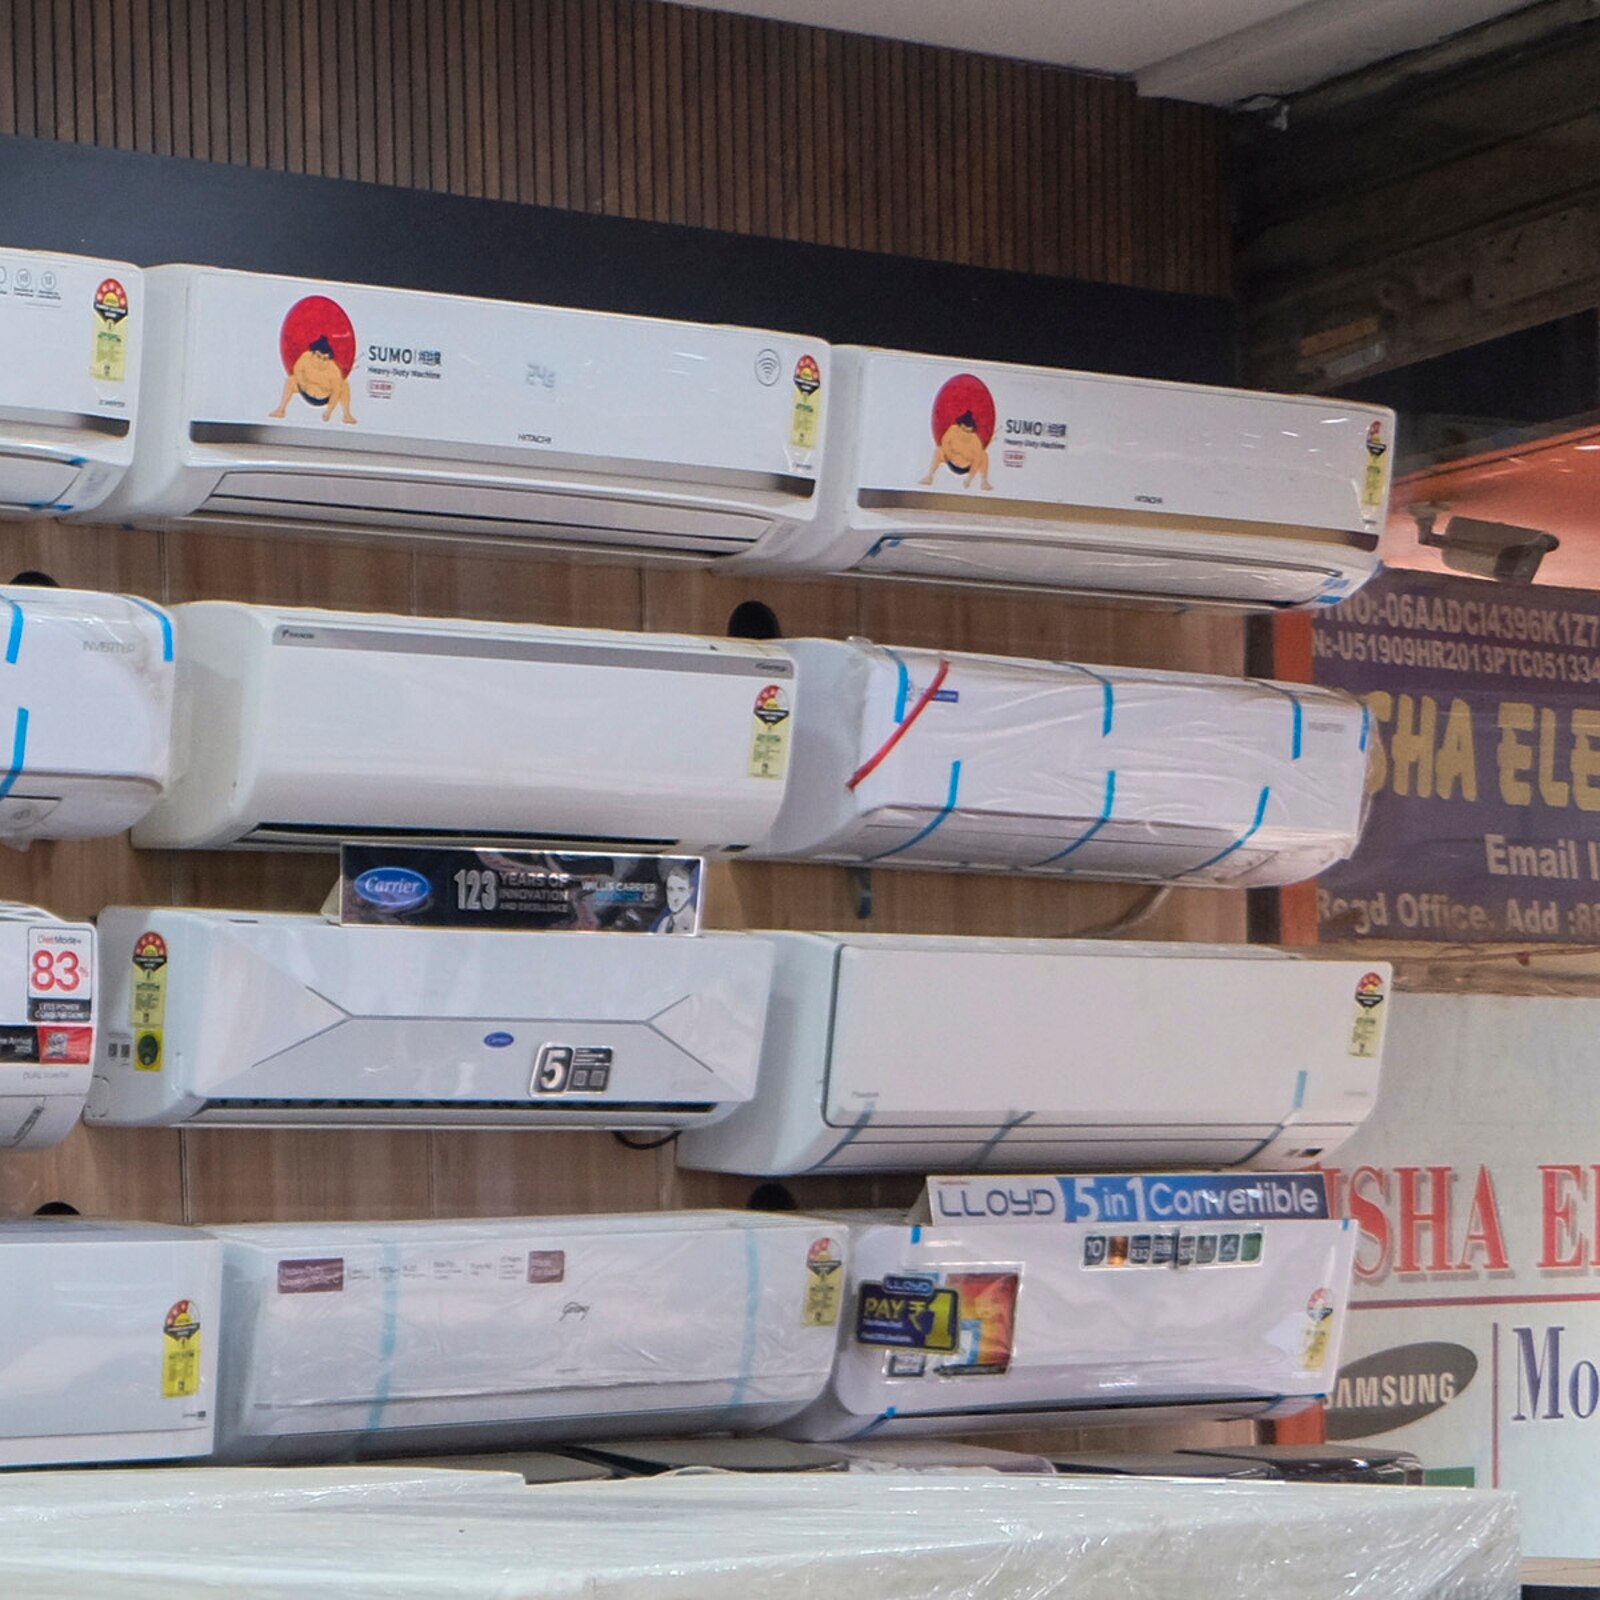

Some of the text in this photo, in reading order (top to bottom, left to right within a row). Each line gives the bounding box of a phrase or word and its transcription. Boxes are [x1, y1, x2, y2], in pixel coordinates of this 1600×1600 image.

[368, 345, 413, 365] SUMO
[1005, 419, 1043, 437] SUMO
[1484, 832, 1579, 881] Email
[364, 868, 570, 912] Carrier 123 YEARS OF
[501, 889, 570, 903] INNOVATION
[1505, 898, 1560, 936] Add
[540, 1049, 567, 1089] 5
[939, 1177, 1319, 1221] LLOYD 5 in 1 Convertible
[1085, 1239, 1101, 1257] 10
[863, 1297, 902, 1321] PAY
